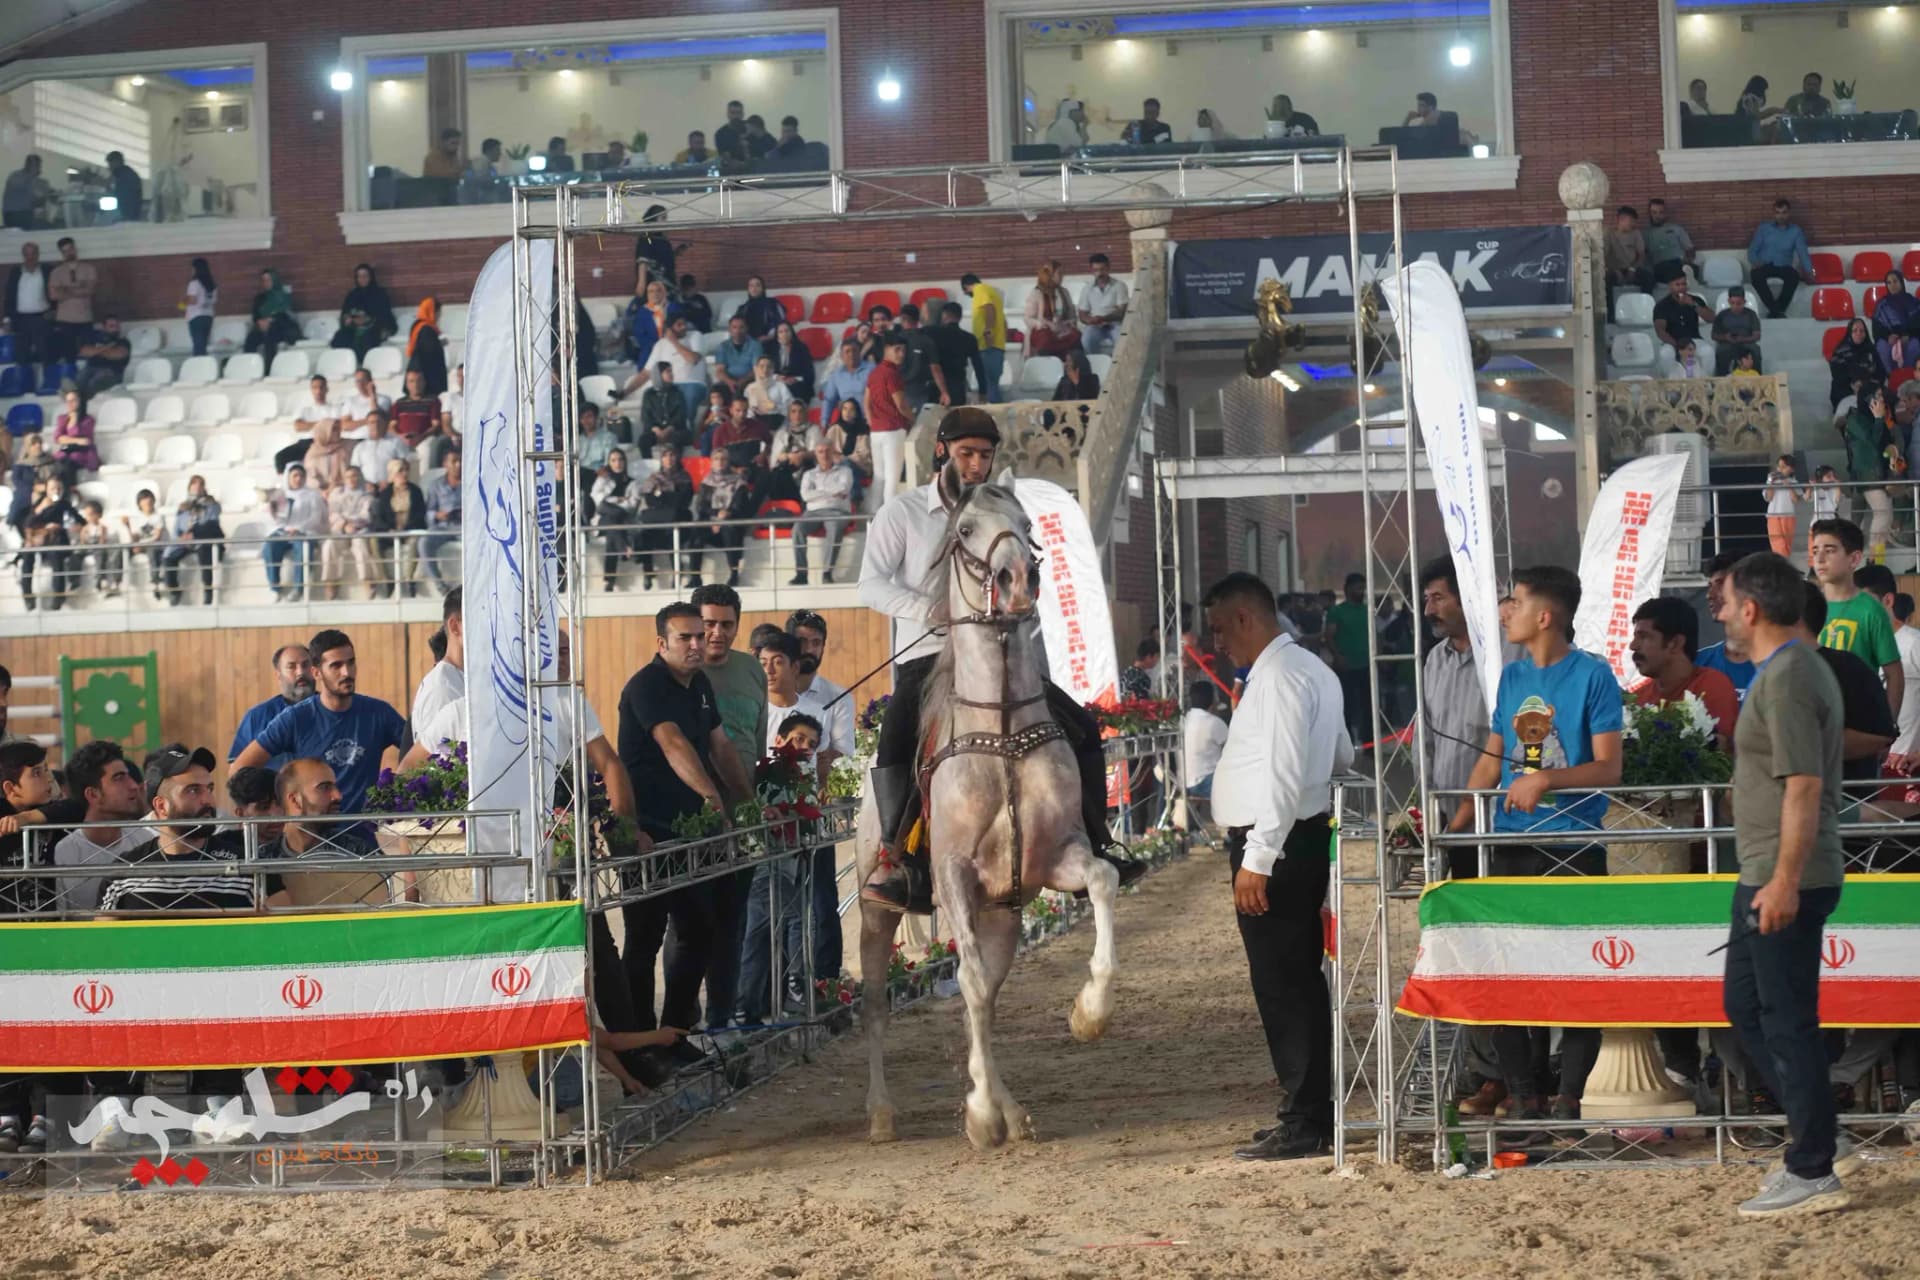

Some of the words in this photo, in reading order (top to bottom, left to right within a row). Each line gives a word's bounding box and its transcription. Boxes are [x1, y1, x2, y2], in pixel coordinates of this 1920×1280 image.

[1476, 241, 1500, 250] CUP
[1254, 250, 1499, 300] MAHK
[535, 481, 557, 561] Riding
